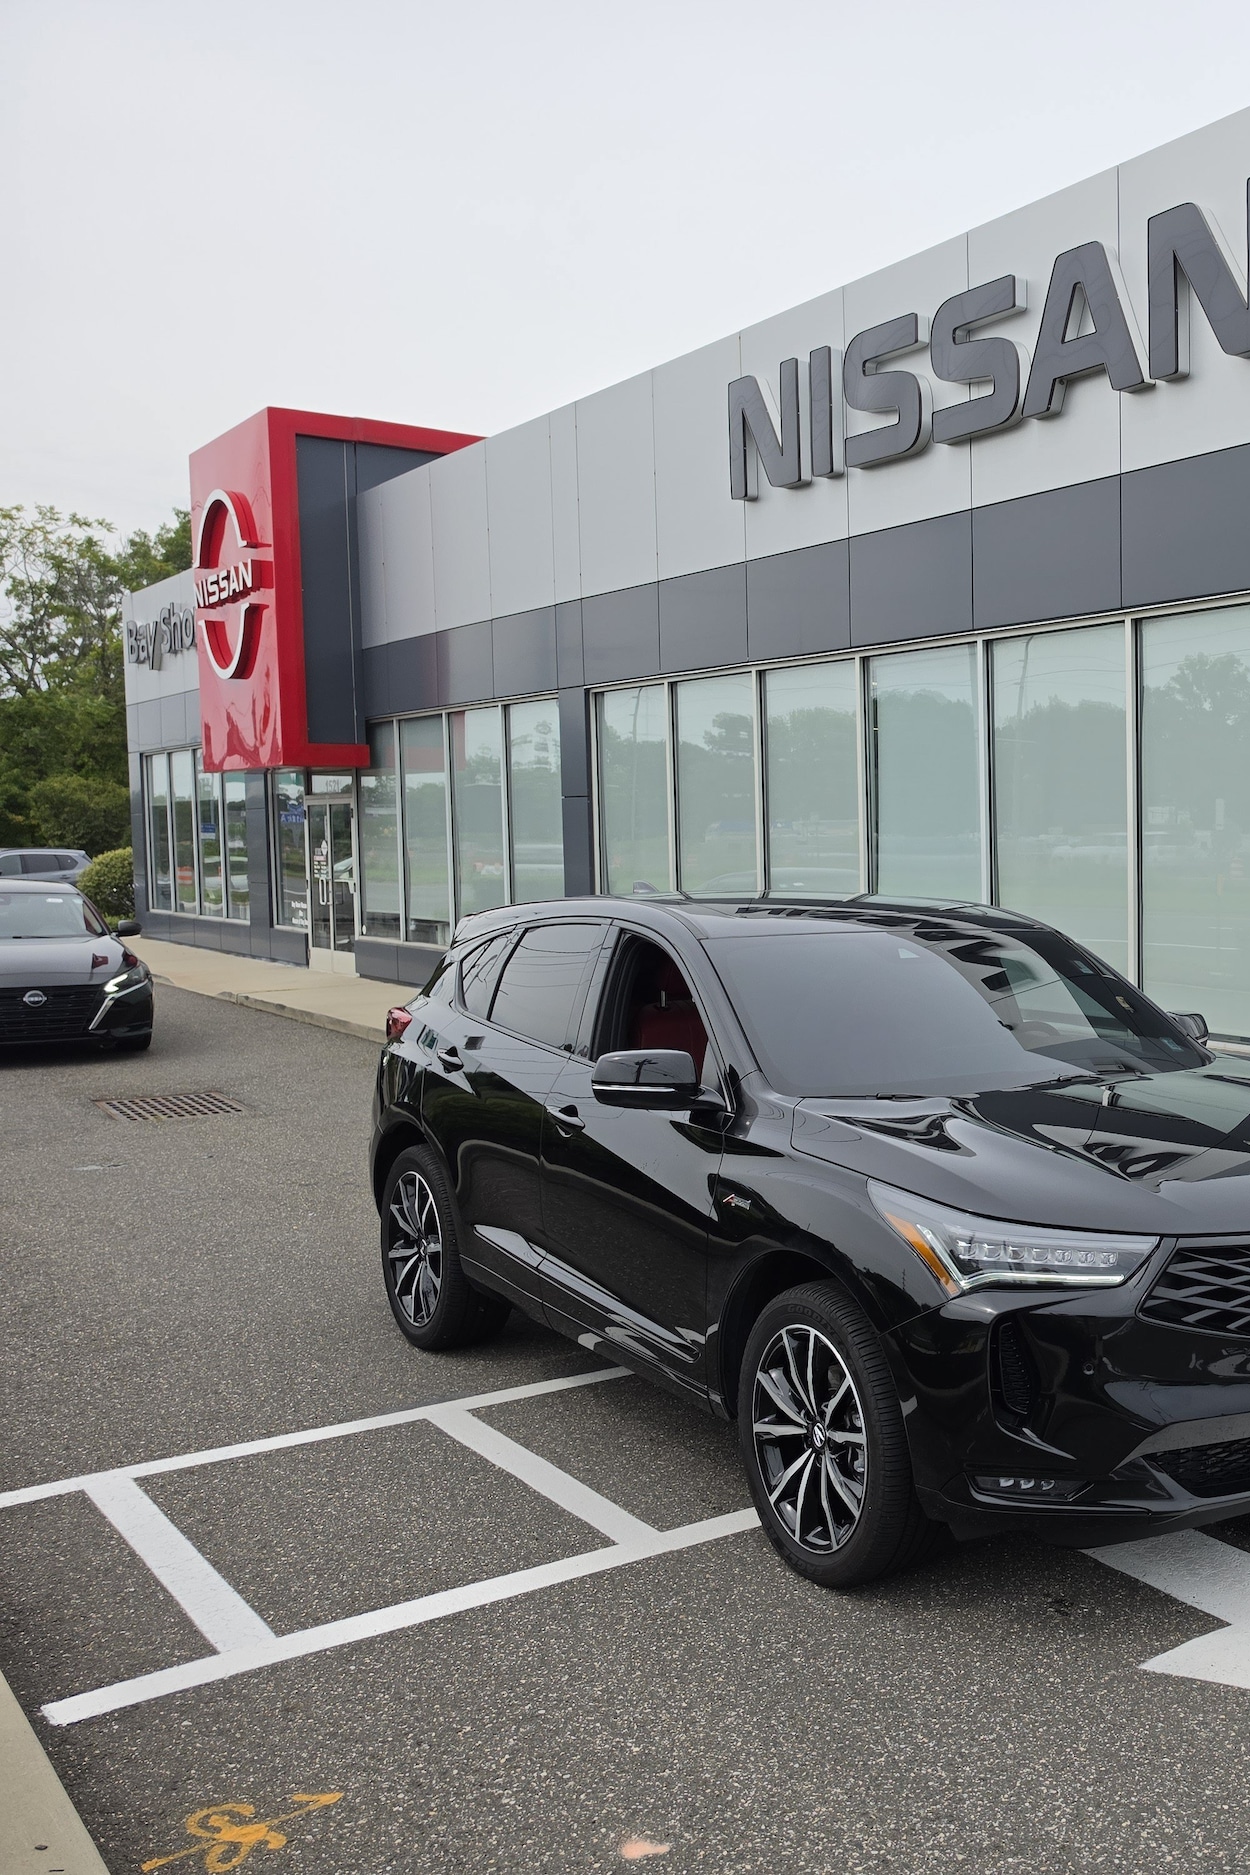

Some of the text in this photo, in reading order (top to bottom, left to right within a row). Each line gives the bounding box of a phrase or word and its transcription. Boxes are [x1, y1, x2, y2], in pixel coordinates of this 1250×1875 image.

[193, 558, 253, 609] NISSAN
[127, 602, 197, 671] Bay Sho
